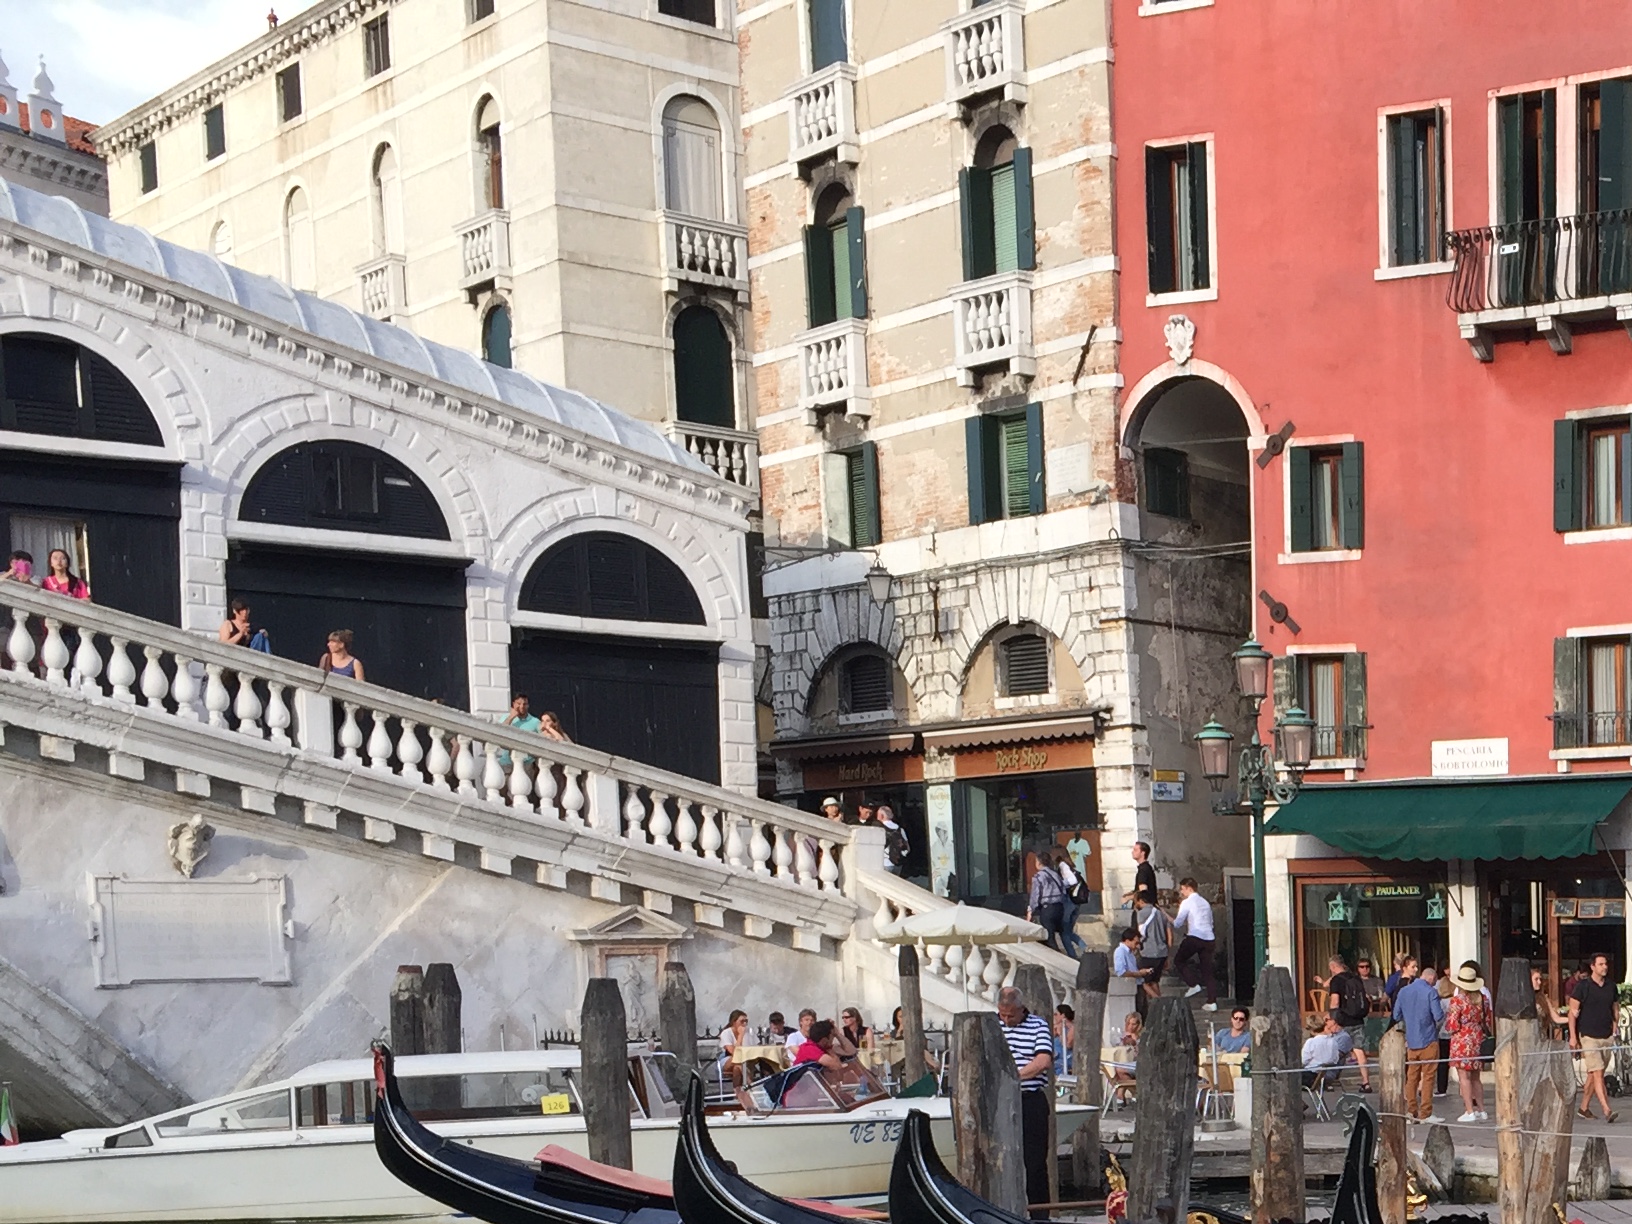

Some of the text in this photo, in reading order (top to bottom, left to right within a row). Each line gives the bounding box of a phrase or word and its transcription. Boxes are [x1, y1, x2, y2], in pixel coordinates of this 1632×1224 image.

[995, 746, 1048, 771] Rock Shop
[839, 764, 860, 780] Hard
[1375, 886, 1420, 896] PAULANER
[548, 1102, 564, 1110] 126
[850, 1122, 876, 1144] VE
